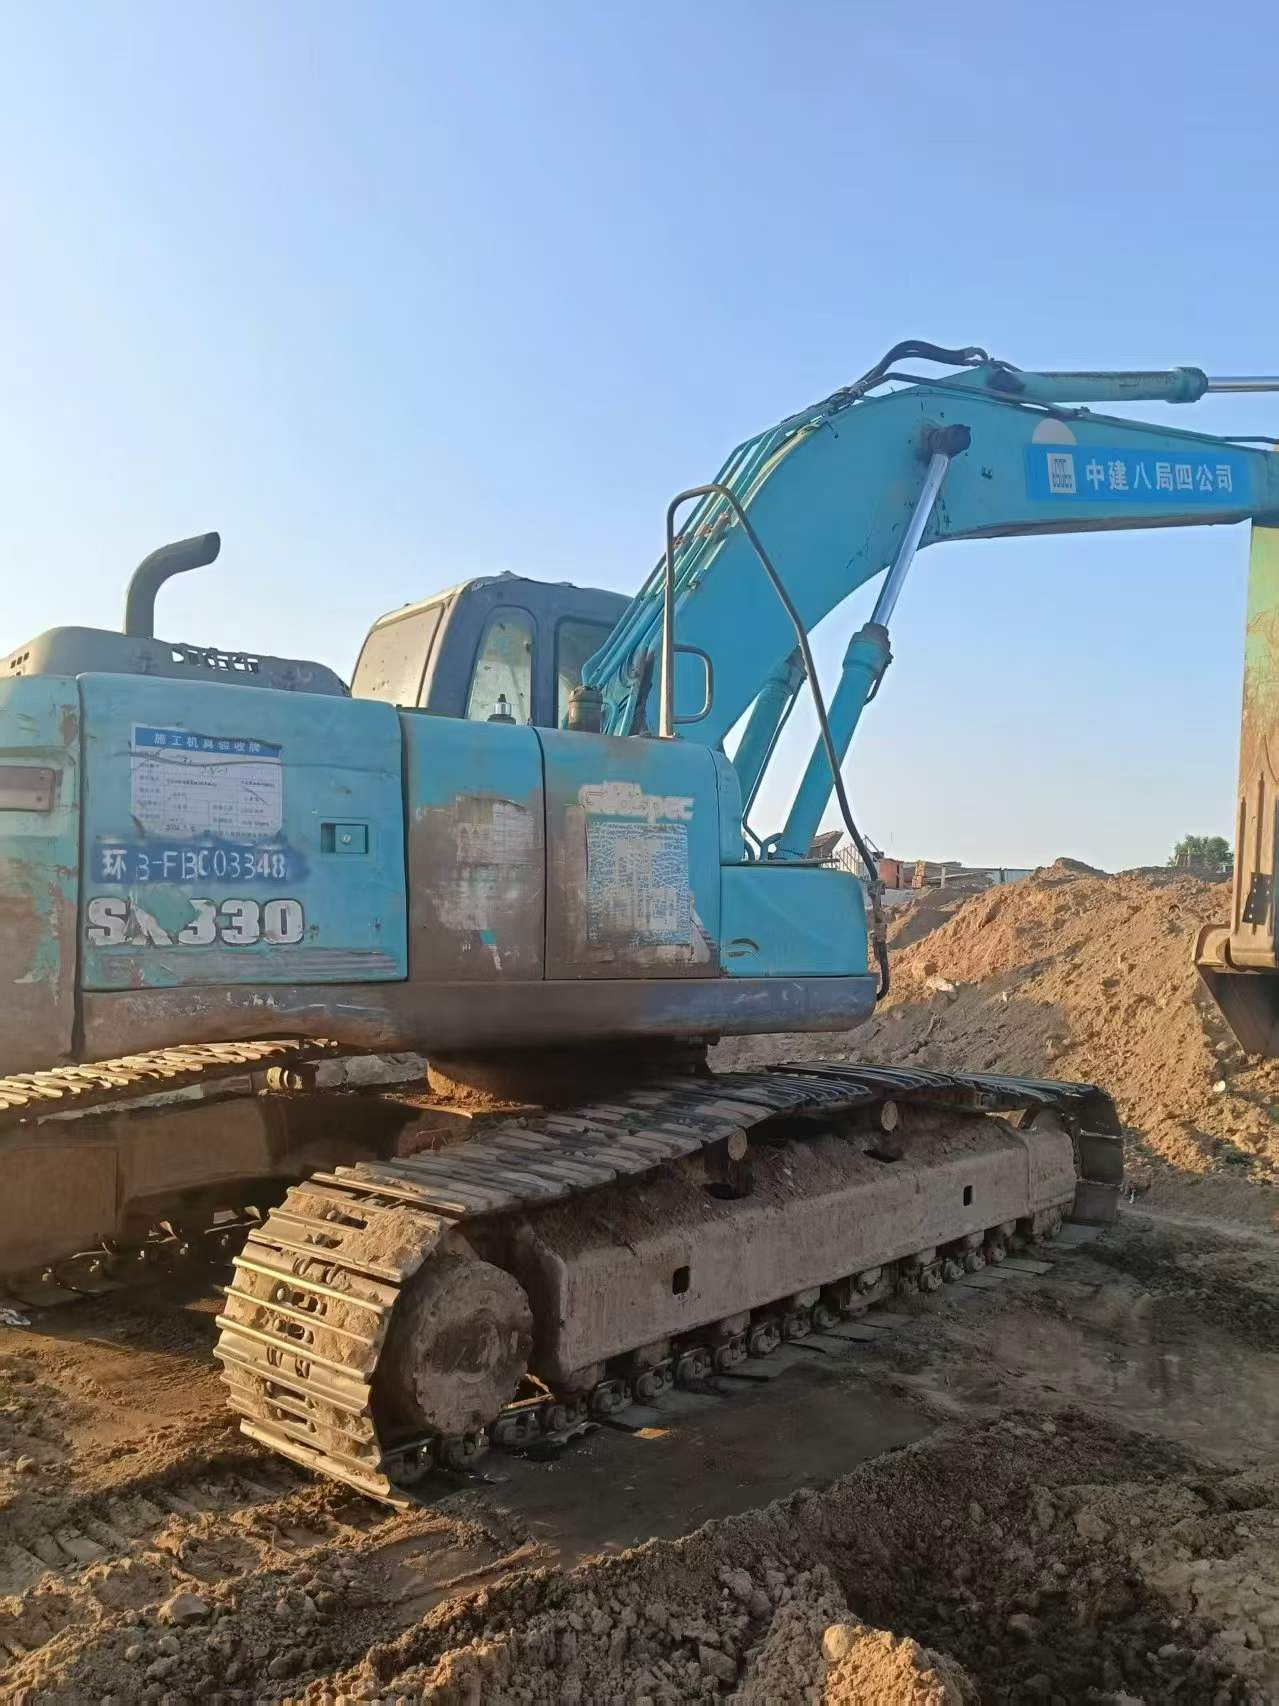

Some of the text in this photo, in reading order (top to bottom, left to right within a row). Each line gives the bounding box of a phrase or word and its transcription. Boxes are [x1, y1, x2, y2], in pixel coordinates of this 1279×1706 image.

[1086, 458, 1233, 492] 中建八局四公司
[102, 849, 128, 881] 环
